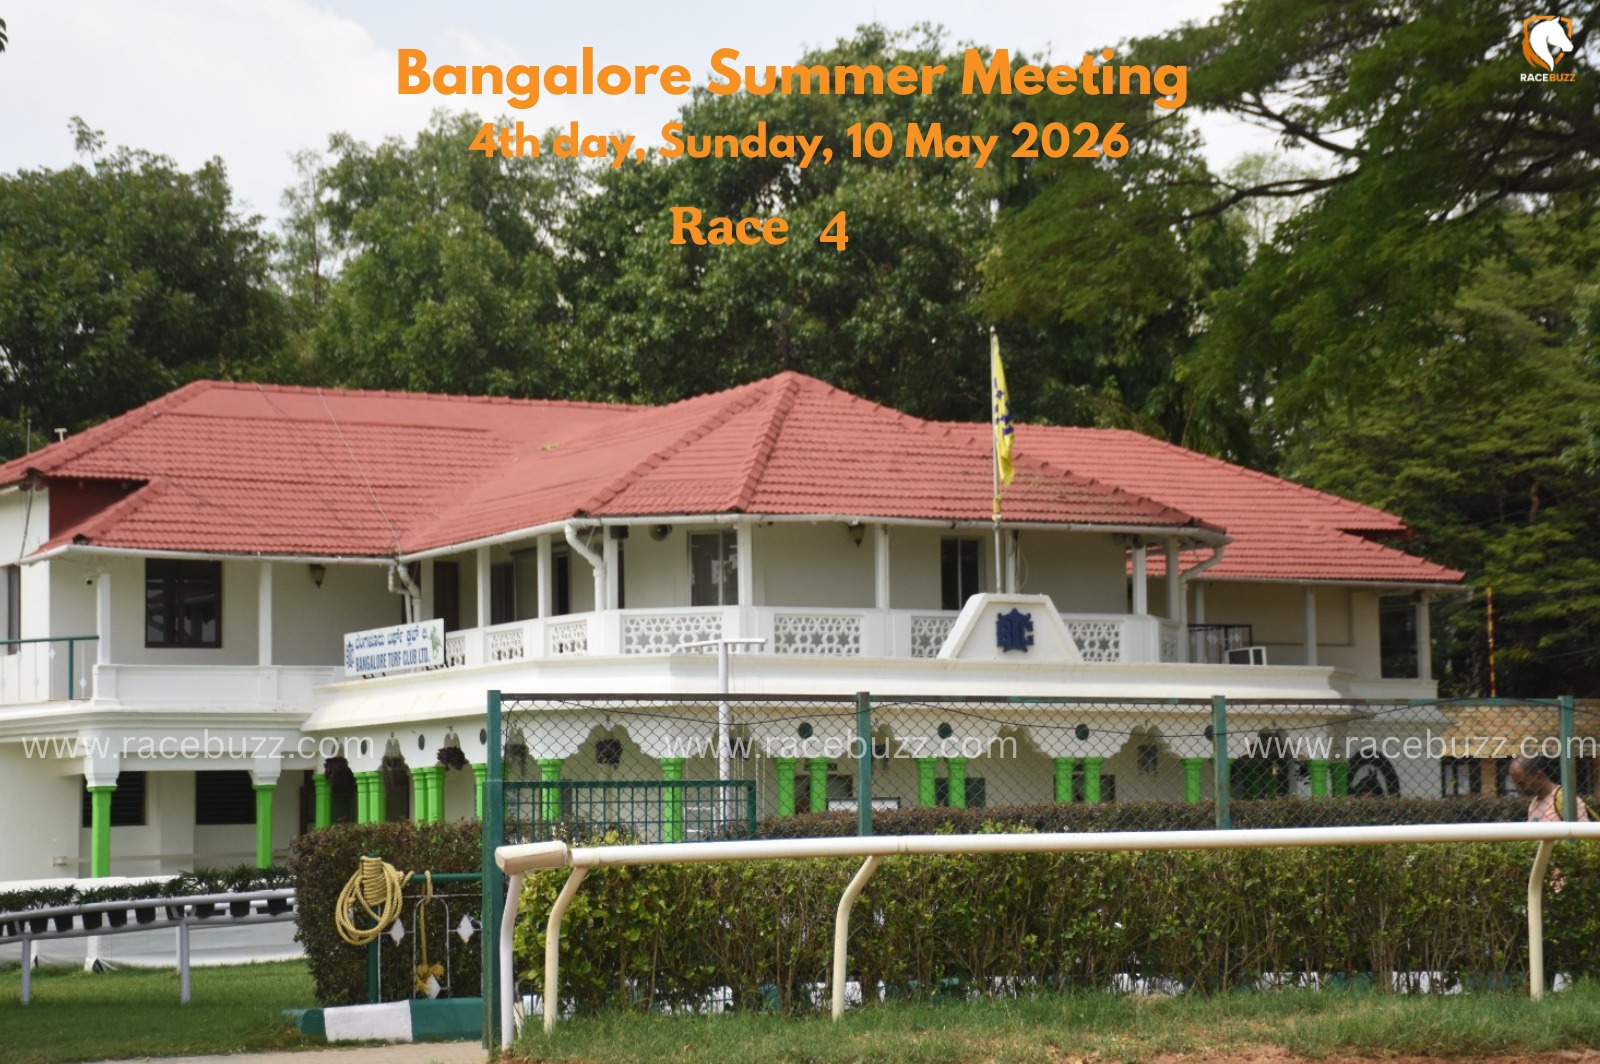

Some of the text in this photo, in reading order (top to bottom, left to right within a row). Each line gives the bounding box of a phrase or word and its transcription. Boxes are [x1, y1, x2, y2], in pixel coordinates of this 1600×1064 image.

[355, 652, 387, 672] BANGALORE
[388, 651, 402, 667] TURF
[403, 648, 417, 665] CLUB
[418, 647, 430, 663] LTD.
